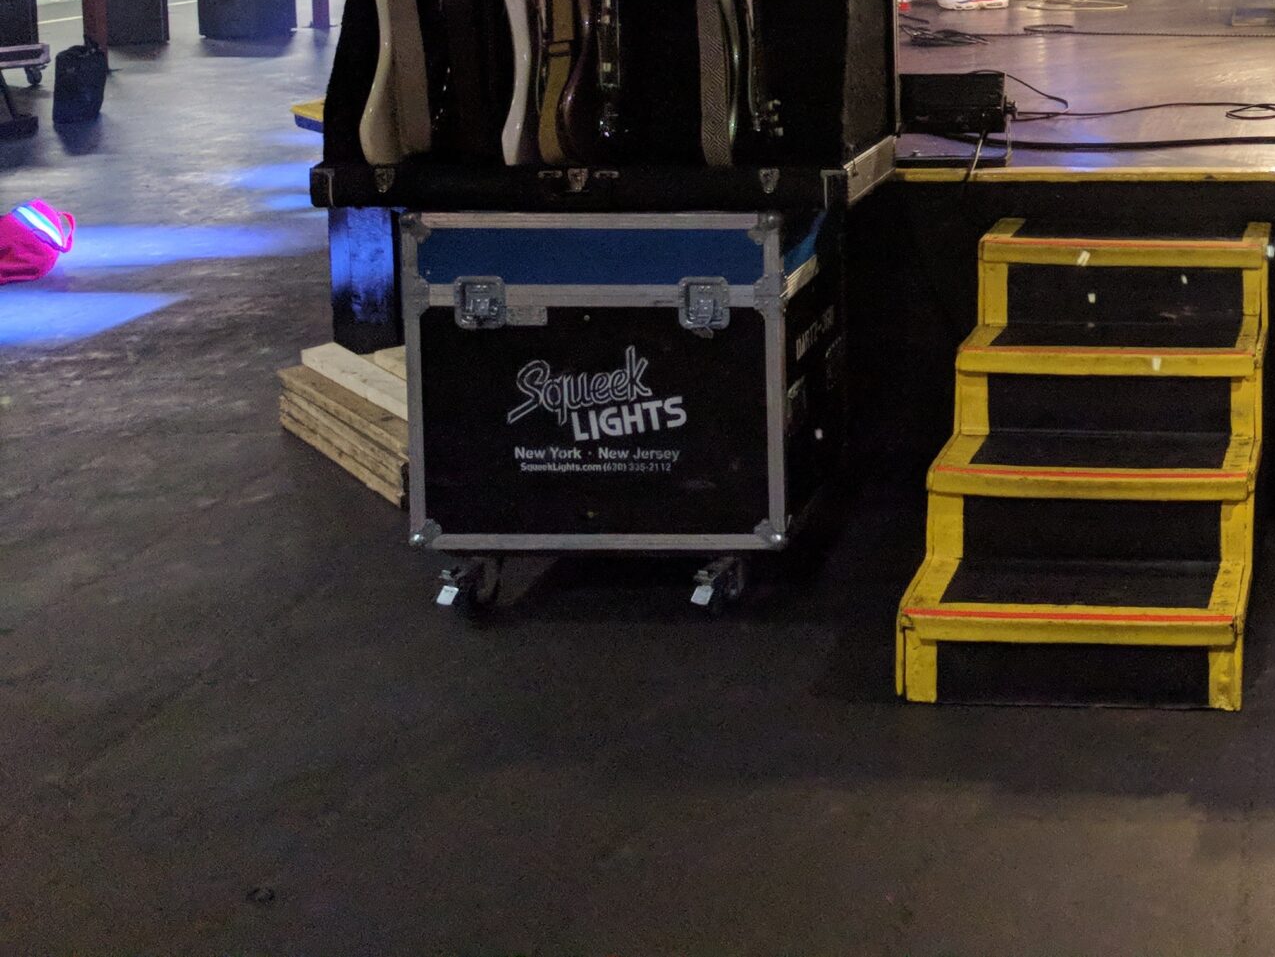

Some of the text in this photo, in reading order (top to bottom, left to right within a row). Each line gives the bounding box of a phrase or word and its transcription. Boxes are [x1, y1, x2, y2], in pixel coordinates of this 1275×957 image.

[507, 344, 653, 427] Squeek
[570, 395, 688, 443] LIGHTS
[514, 446, 681, 462] New York New Jersey
[520, 462, 601, 473] SqueekLights.com
